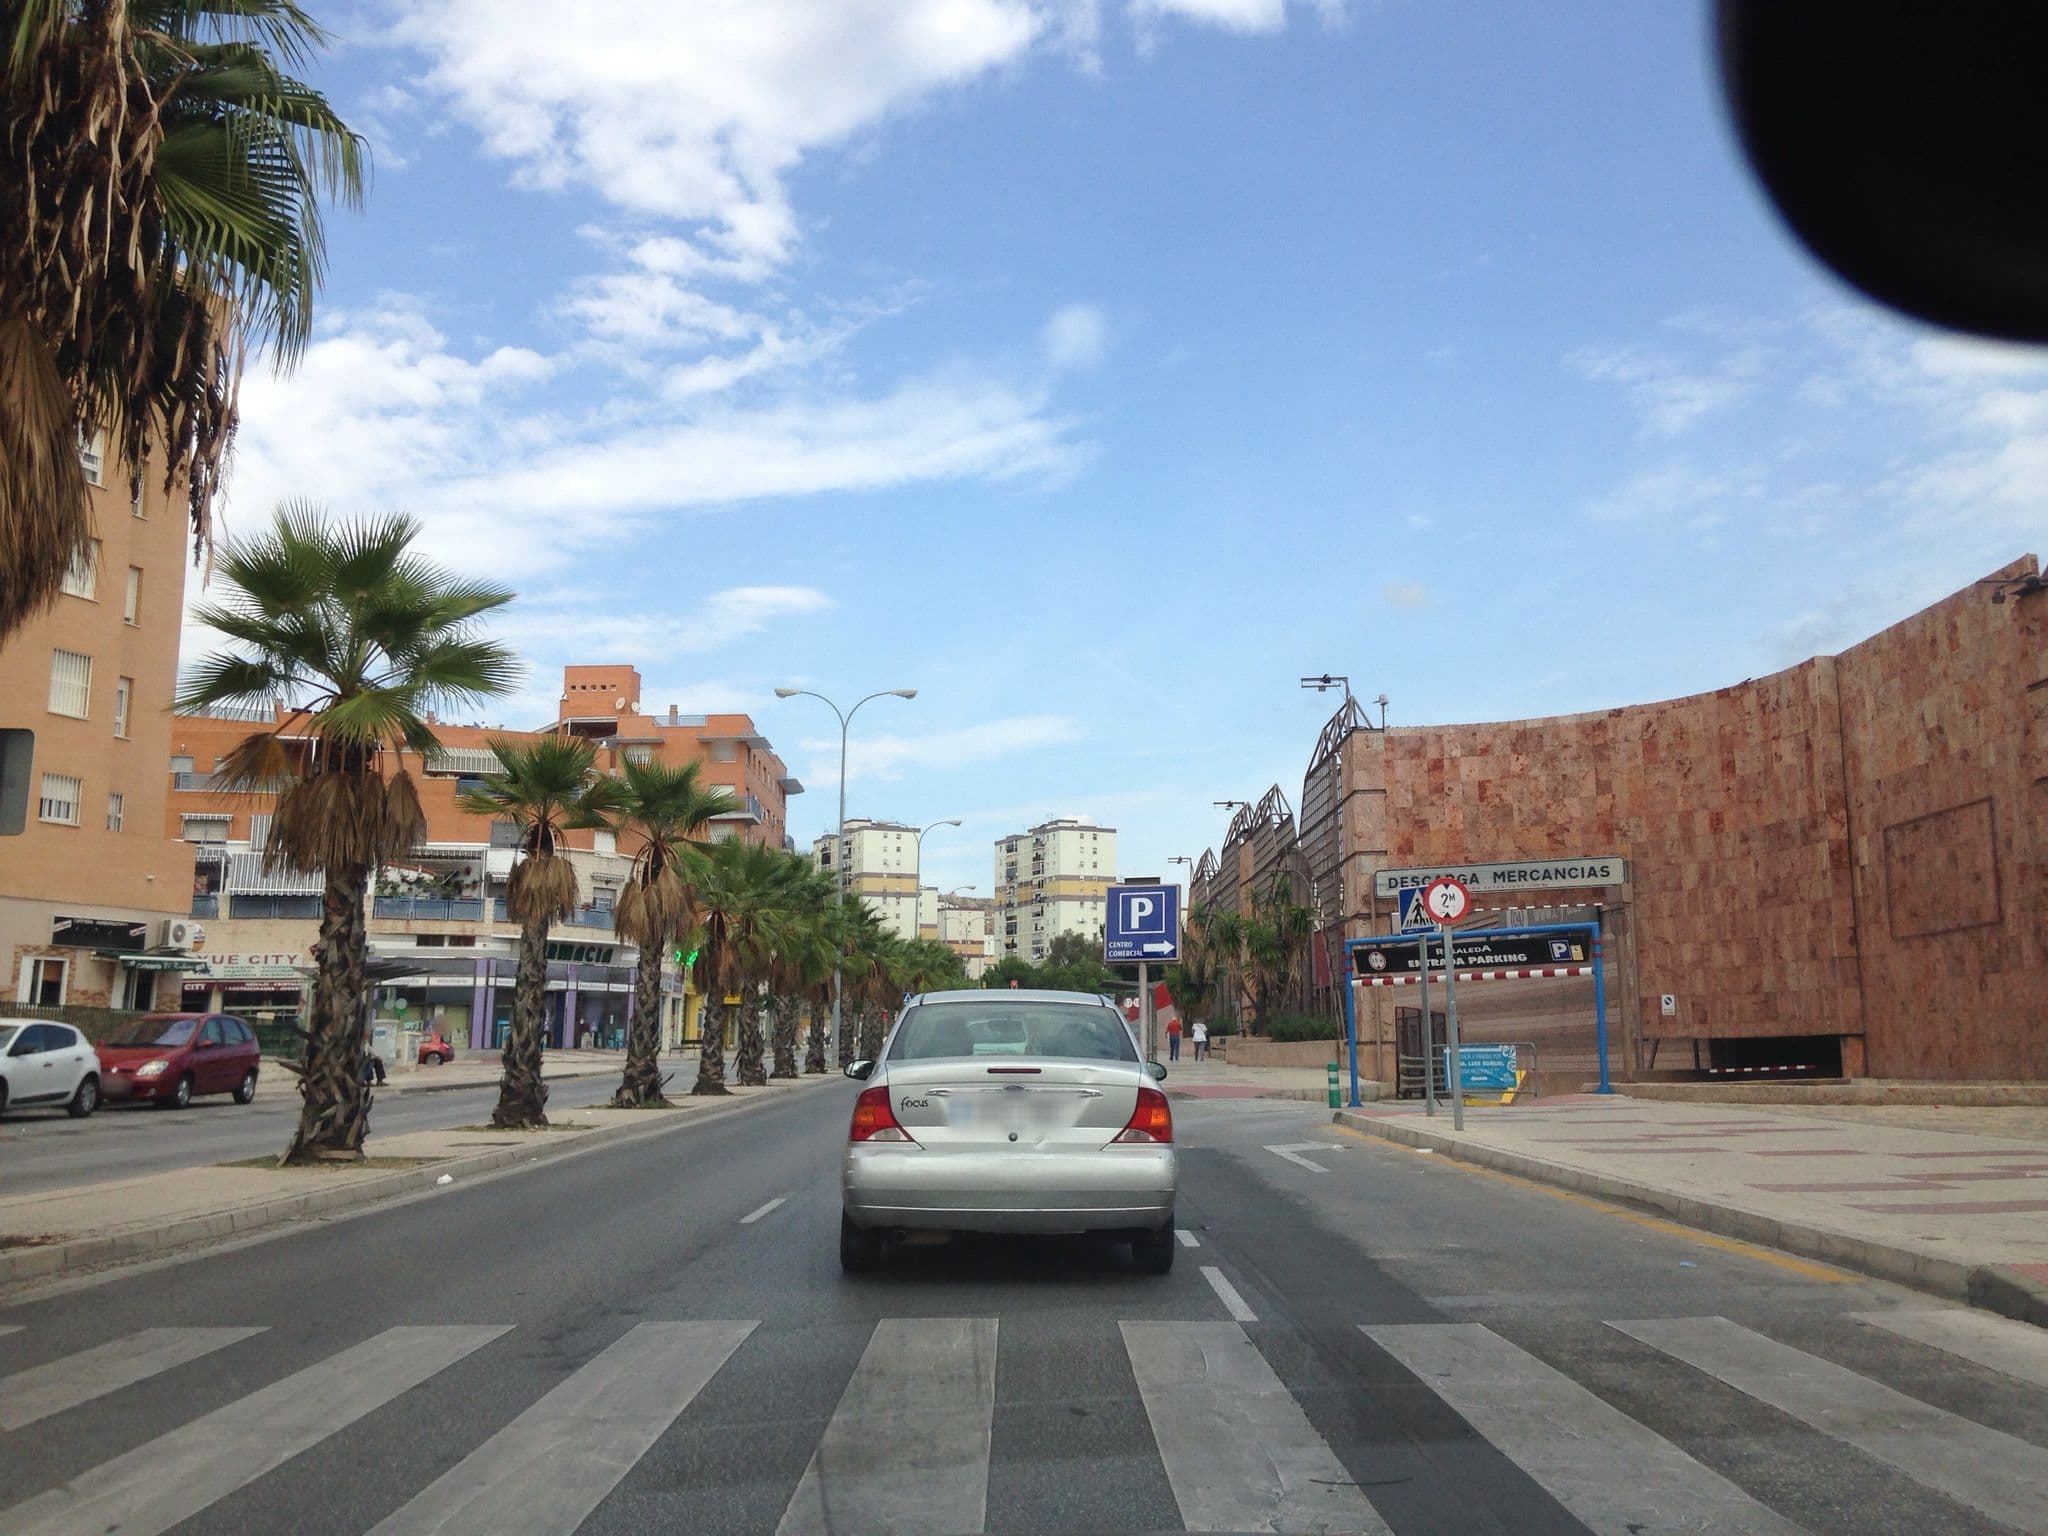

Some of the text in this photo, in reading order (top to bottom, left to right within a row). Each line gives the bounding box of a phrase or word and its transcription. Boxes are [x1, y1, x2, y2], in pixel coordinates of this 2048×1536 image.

[1388, 865, 1611, 889] DESCGA MERCANCIAS
[1131, 897, 1154, 930] P
[1108, 941, 1133, 949] CENTRO
[1551, 942, 1568, 958] P
[1108, 949, 1143, 957] COMERCIAL
[1468, 953, 1528, 965] PARKING
[248, 954, 299, 965] CITY
